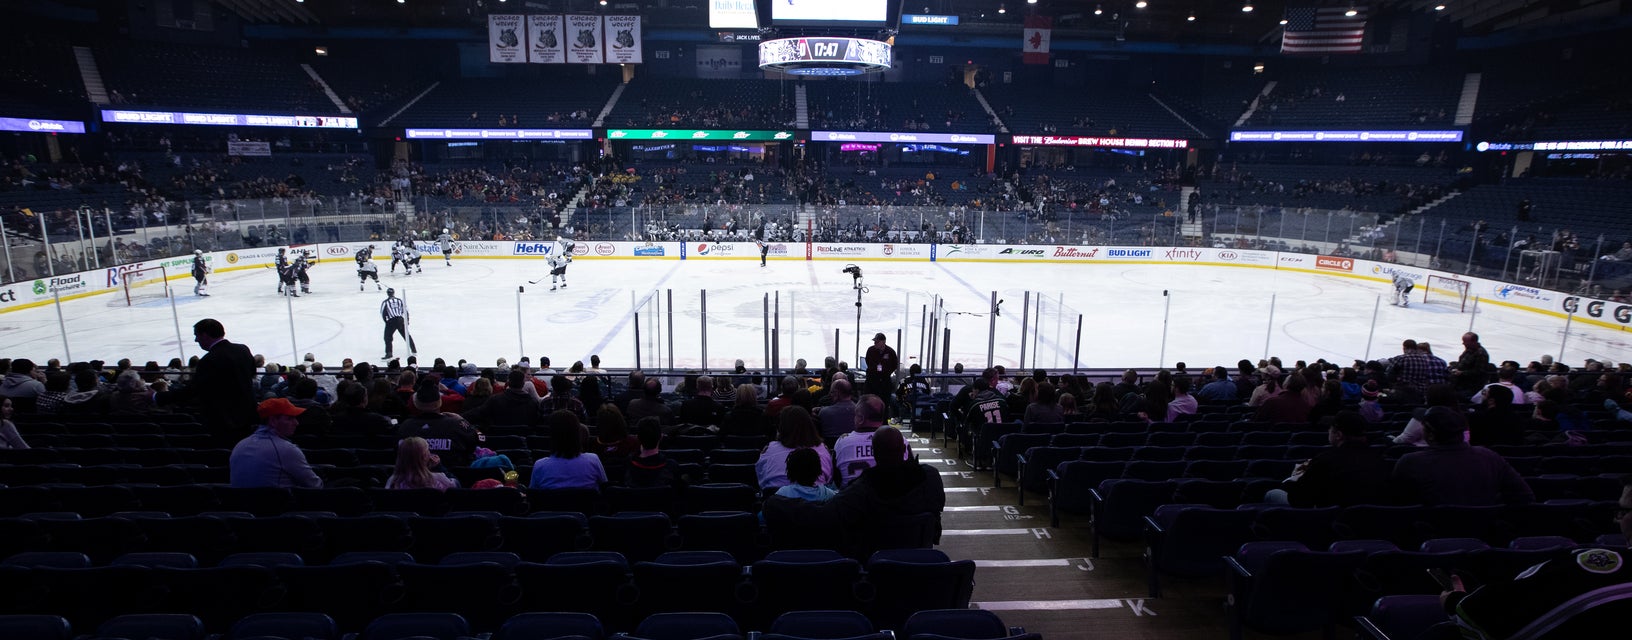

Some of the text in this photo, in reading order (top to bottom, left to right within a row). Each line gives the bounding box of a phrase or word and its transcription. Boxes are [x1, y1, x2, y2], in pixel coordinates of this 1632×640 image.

[928, 16, 948, 24] LIGHT
[814, 42, 839, 57] 17:47
[1013, 136, 1030, 144] VISIT
[1031, 136, 1043, 144] THE
[1044, 136, 1077, 145] Budweiser
[1078, 137, 1099, 145] BREW
[1100, 138, 1124, 146] HOUSE
[1148, 139, 1175, 148] SECTION
[516, 243, 552, 255] Hefty
[711, 244, 734, 252] pepsi
[1053, 246, 1099, 258] Butternut
[1127, 249, 1151, 257] LIGHT
[1165, 247, 1202, 261] xfinity
[1318, 259, 1341, 267] CIRCLE
[49, 275, 81, 288] Flood
[1563, 296, 1632, 323] G G G
[984, 409, 1003, 424] 11
[945, 458, 957, 466] D
[960, 471, 975, 479] E
[977, 487, 991, 496] F
[1003, 505, 1020, 515] G
[1031, 527, 1052, 540] H
[1076, 557, 1095, 572] J
[1125, 598, 1157, 616] K
